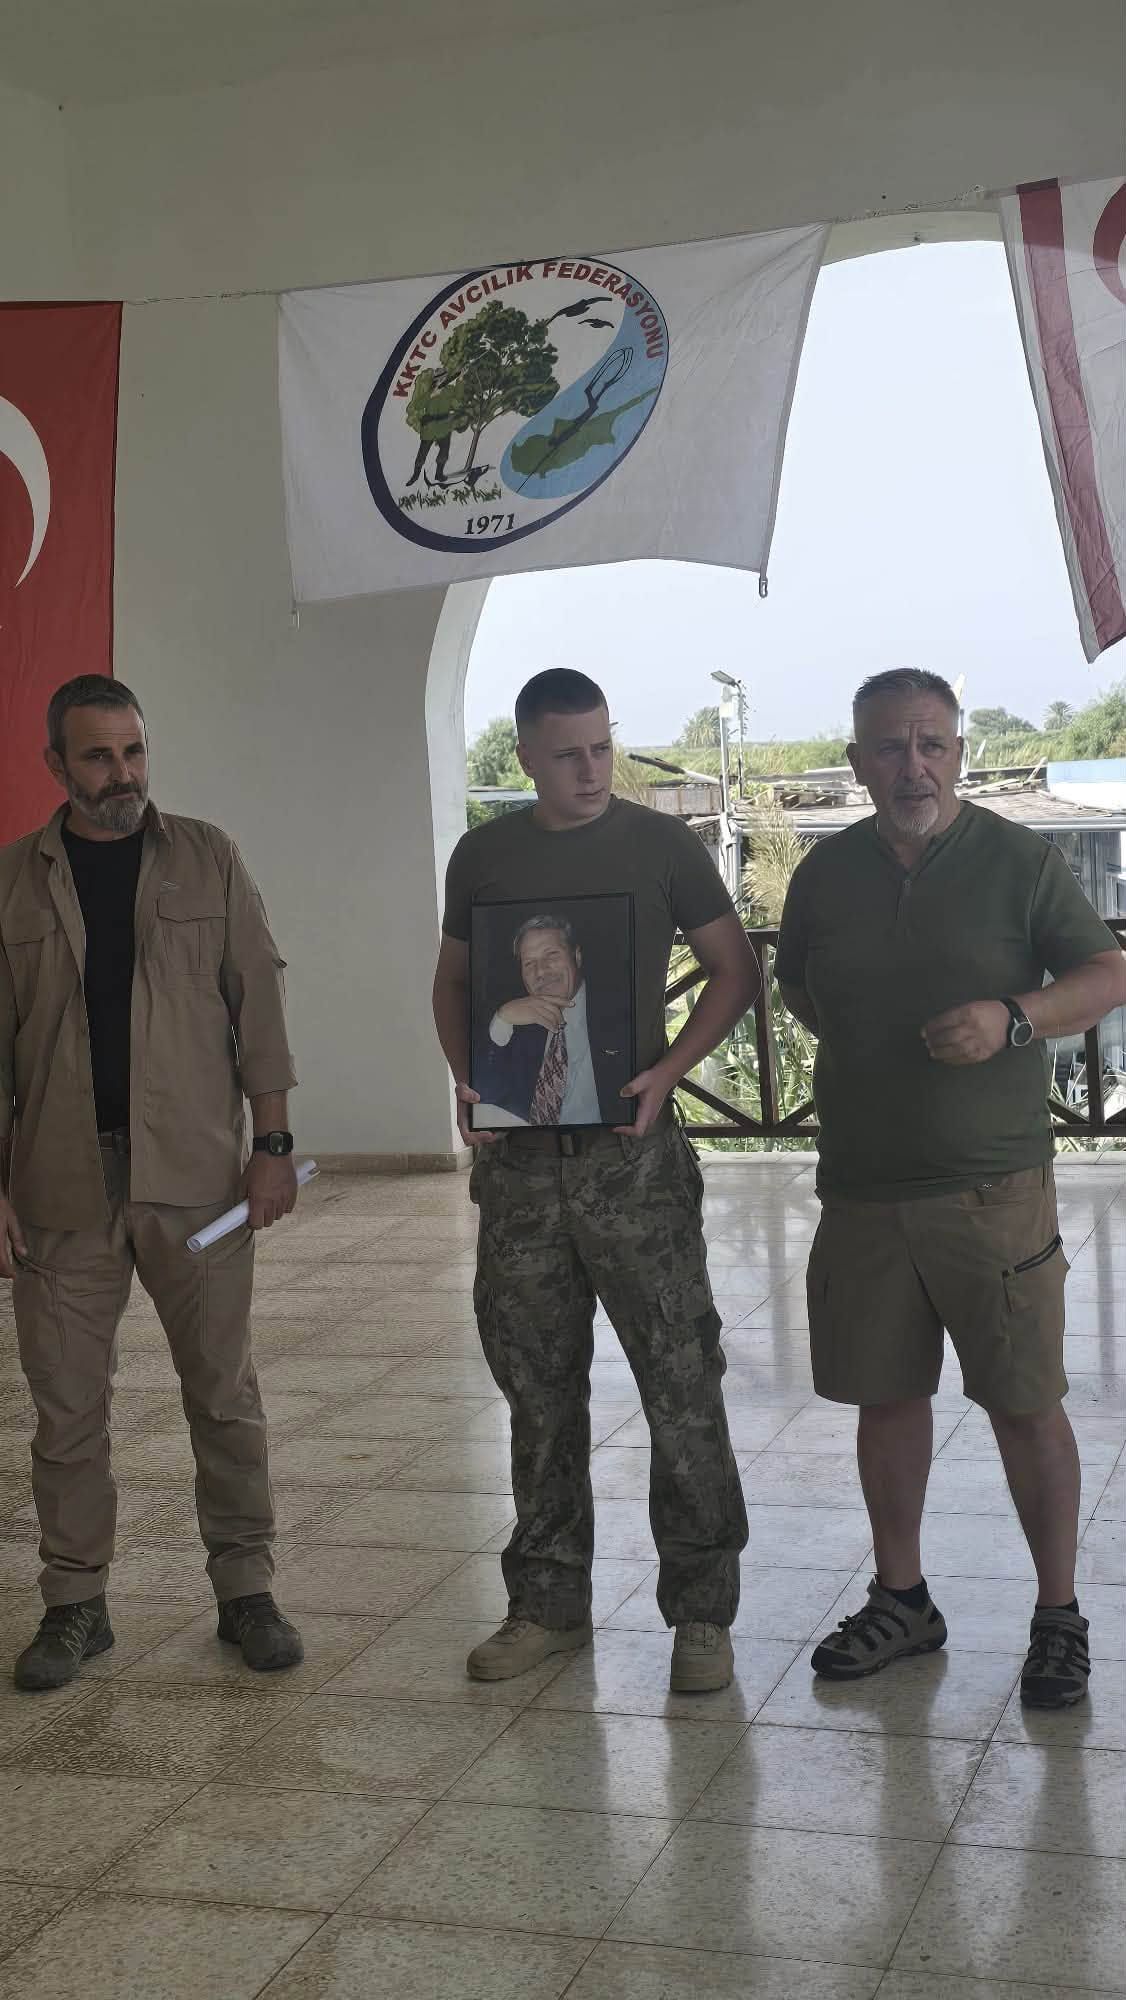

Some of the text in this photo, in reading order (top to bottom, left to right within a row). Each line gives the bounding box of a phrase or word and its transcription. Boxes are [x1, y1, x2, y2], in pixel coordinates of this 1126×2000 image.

[393, 262, 664, 398] KKTC AVCILIK FEDERASYONU
[464, 513, 515, 535] 1971
